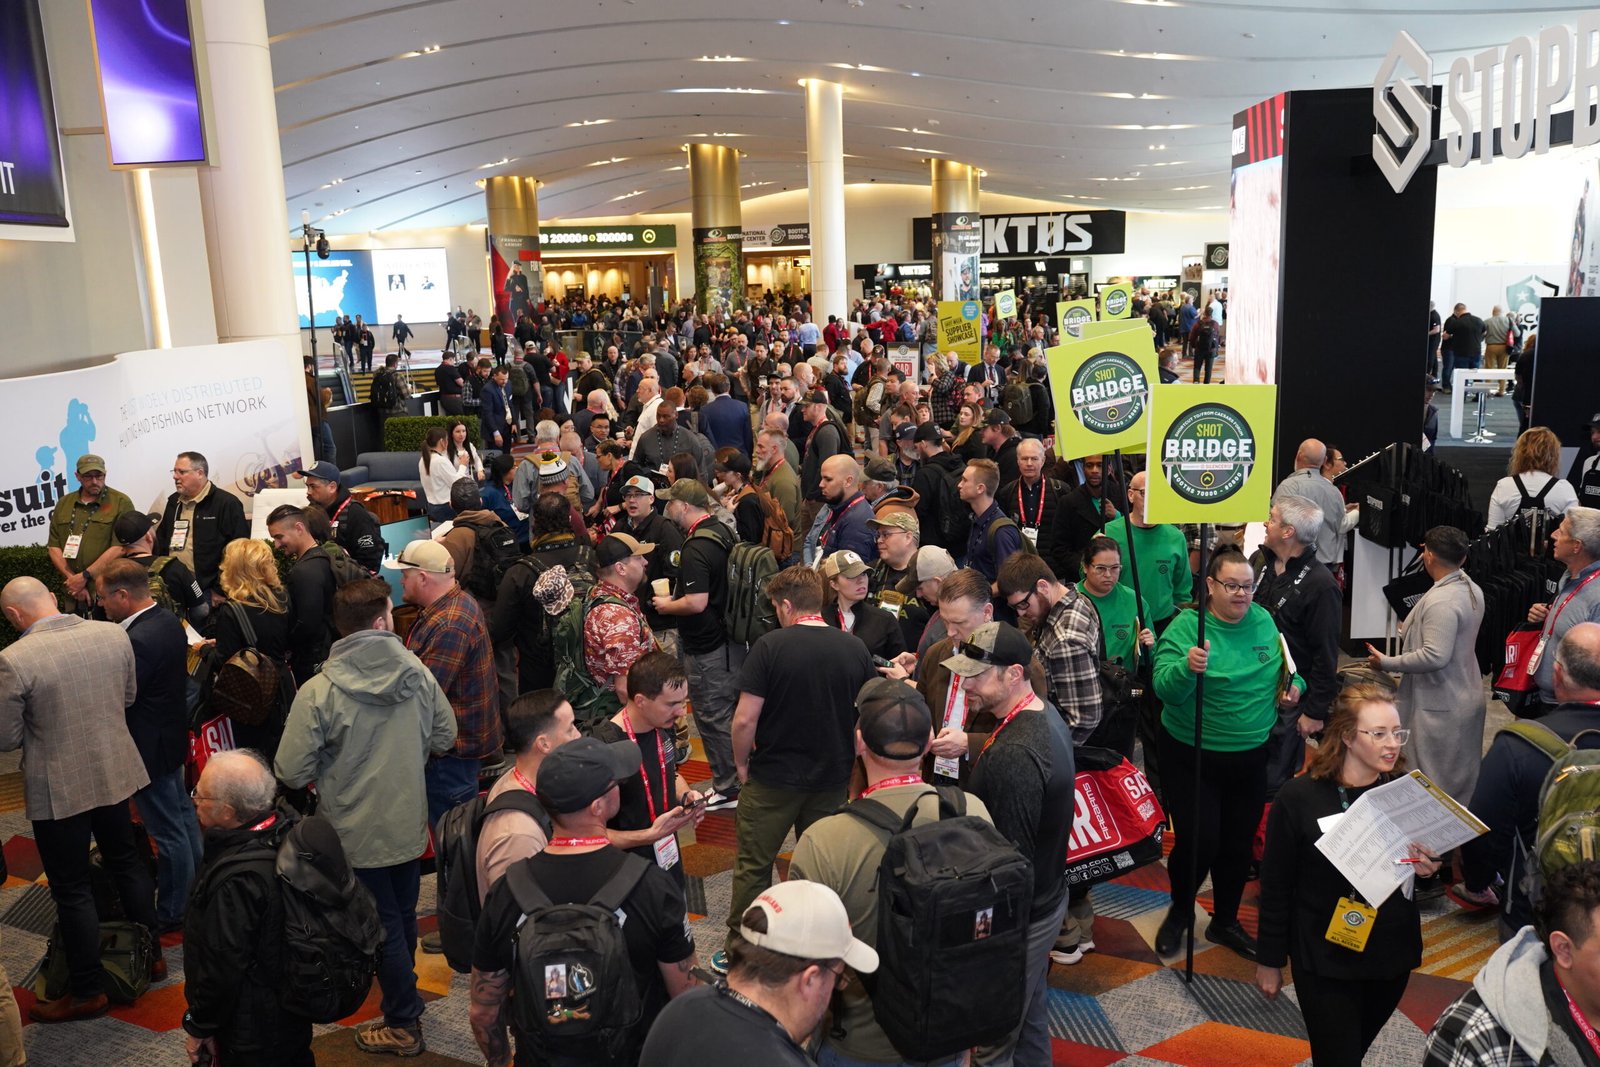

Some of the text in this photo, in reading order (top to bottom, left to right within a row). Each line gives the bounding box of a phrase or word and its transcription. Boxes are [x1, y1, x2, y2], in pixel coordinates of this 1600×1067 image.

[1064, 315, 1092, 325] BRIDGE
[945, 322, 972, 337] SUPPLIER
[947, 330, 974, 345] SHOWCASE
[1095, 367, 1117, 382] SHOT
[172, 376, 264, 403] DISTRIBUTED
[1072, 373, 1145, 404] BRIDGE
[151, 407, 194, 431] FISHING
[197, 395, 268, 421] NETWORK
[1196, 424, 1223, 437] SHOT
[1165, 438, 1252, 457] BRIDGE
[1173, 473, 1195, 494] BOOTHS
[21, 514, 46, 529] the
[1082, 782, 1112, 840] FIREARMS
[1341, 940, 1361, 949] ACCESS
